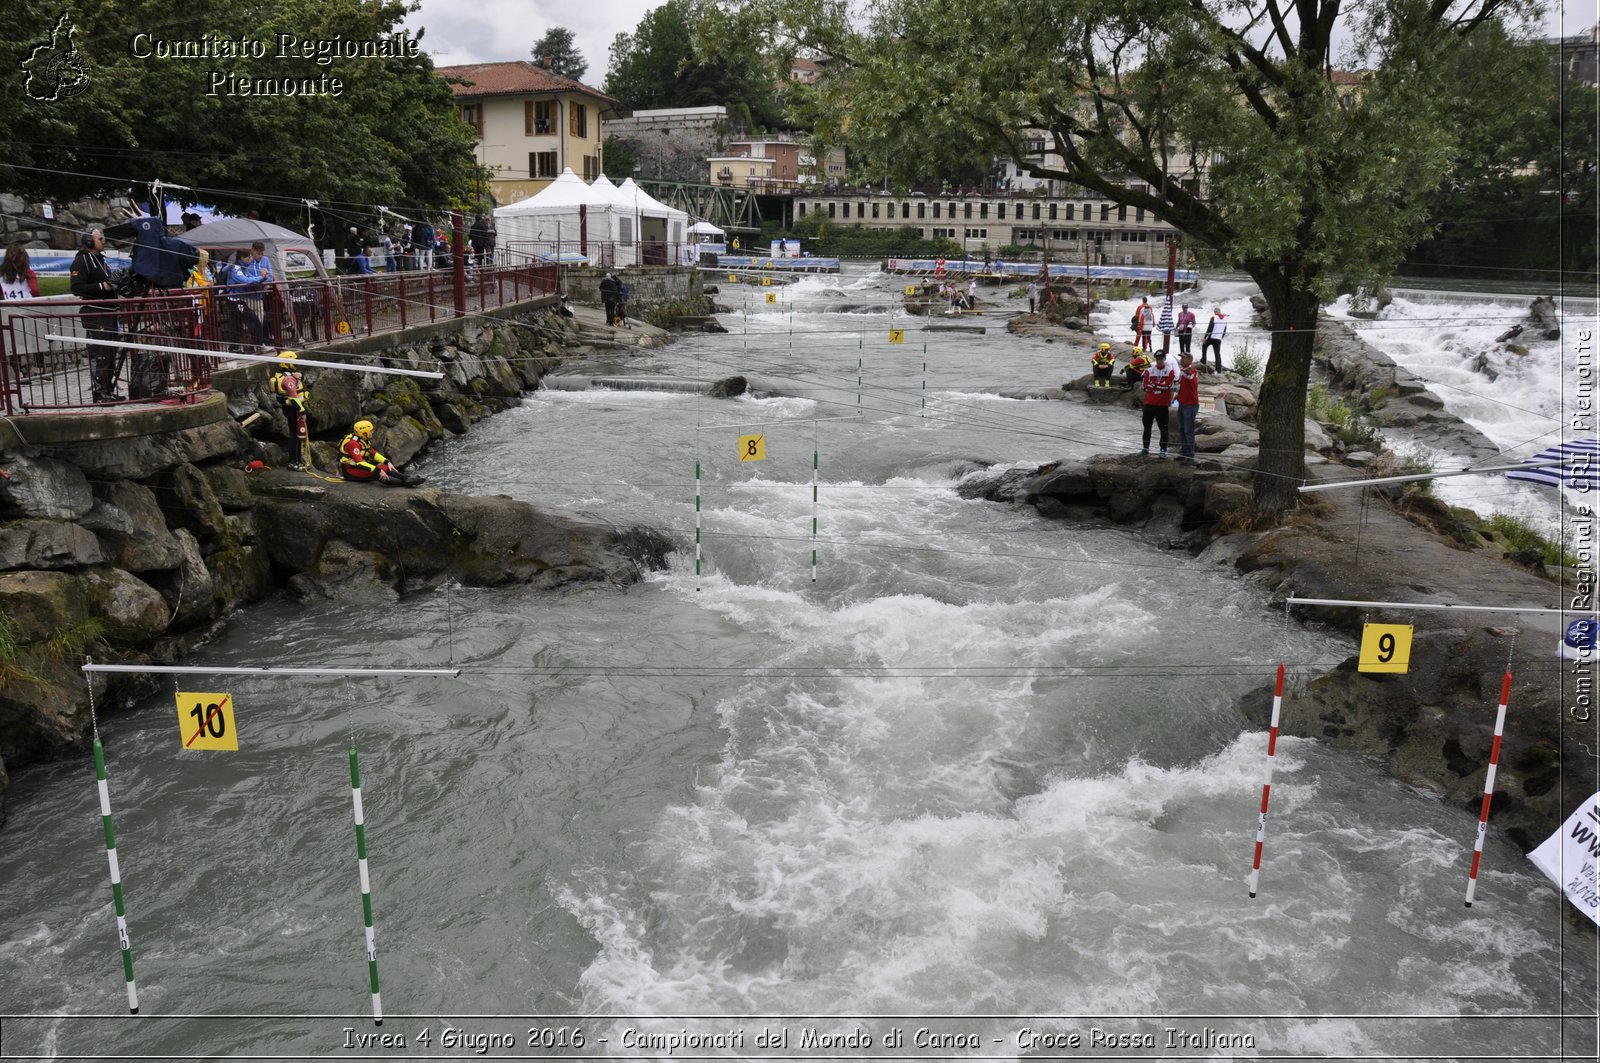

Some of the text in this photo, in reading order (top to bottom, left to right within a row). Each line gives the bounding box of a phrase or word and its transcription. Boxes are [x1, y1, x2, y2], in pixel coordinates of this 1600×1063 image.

[894, 331, 901, 341] 7
[748, 440, 757, 455] 8
[1378, 633, 1395, 663] 9
[190, 703, 225, 738] 10
